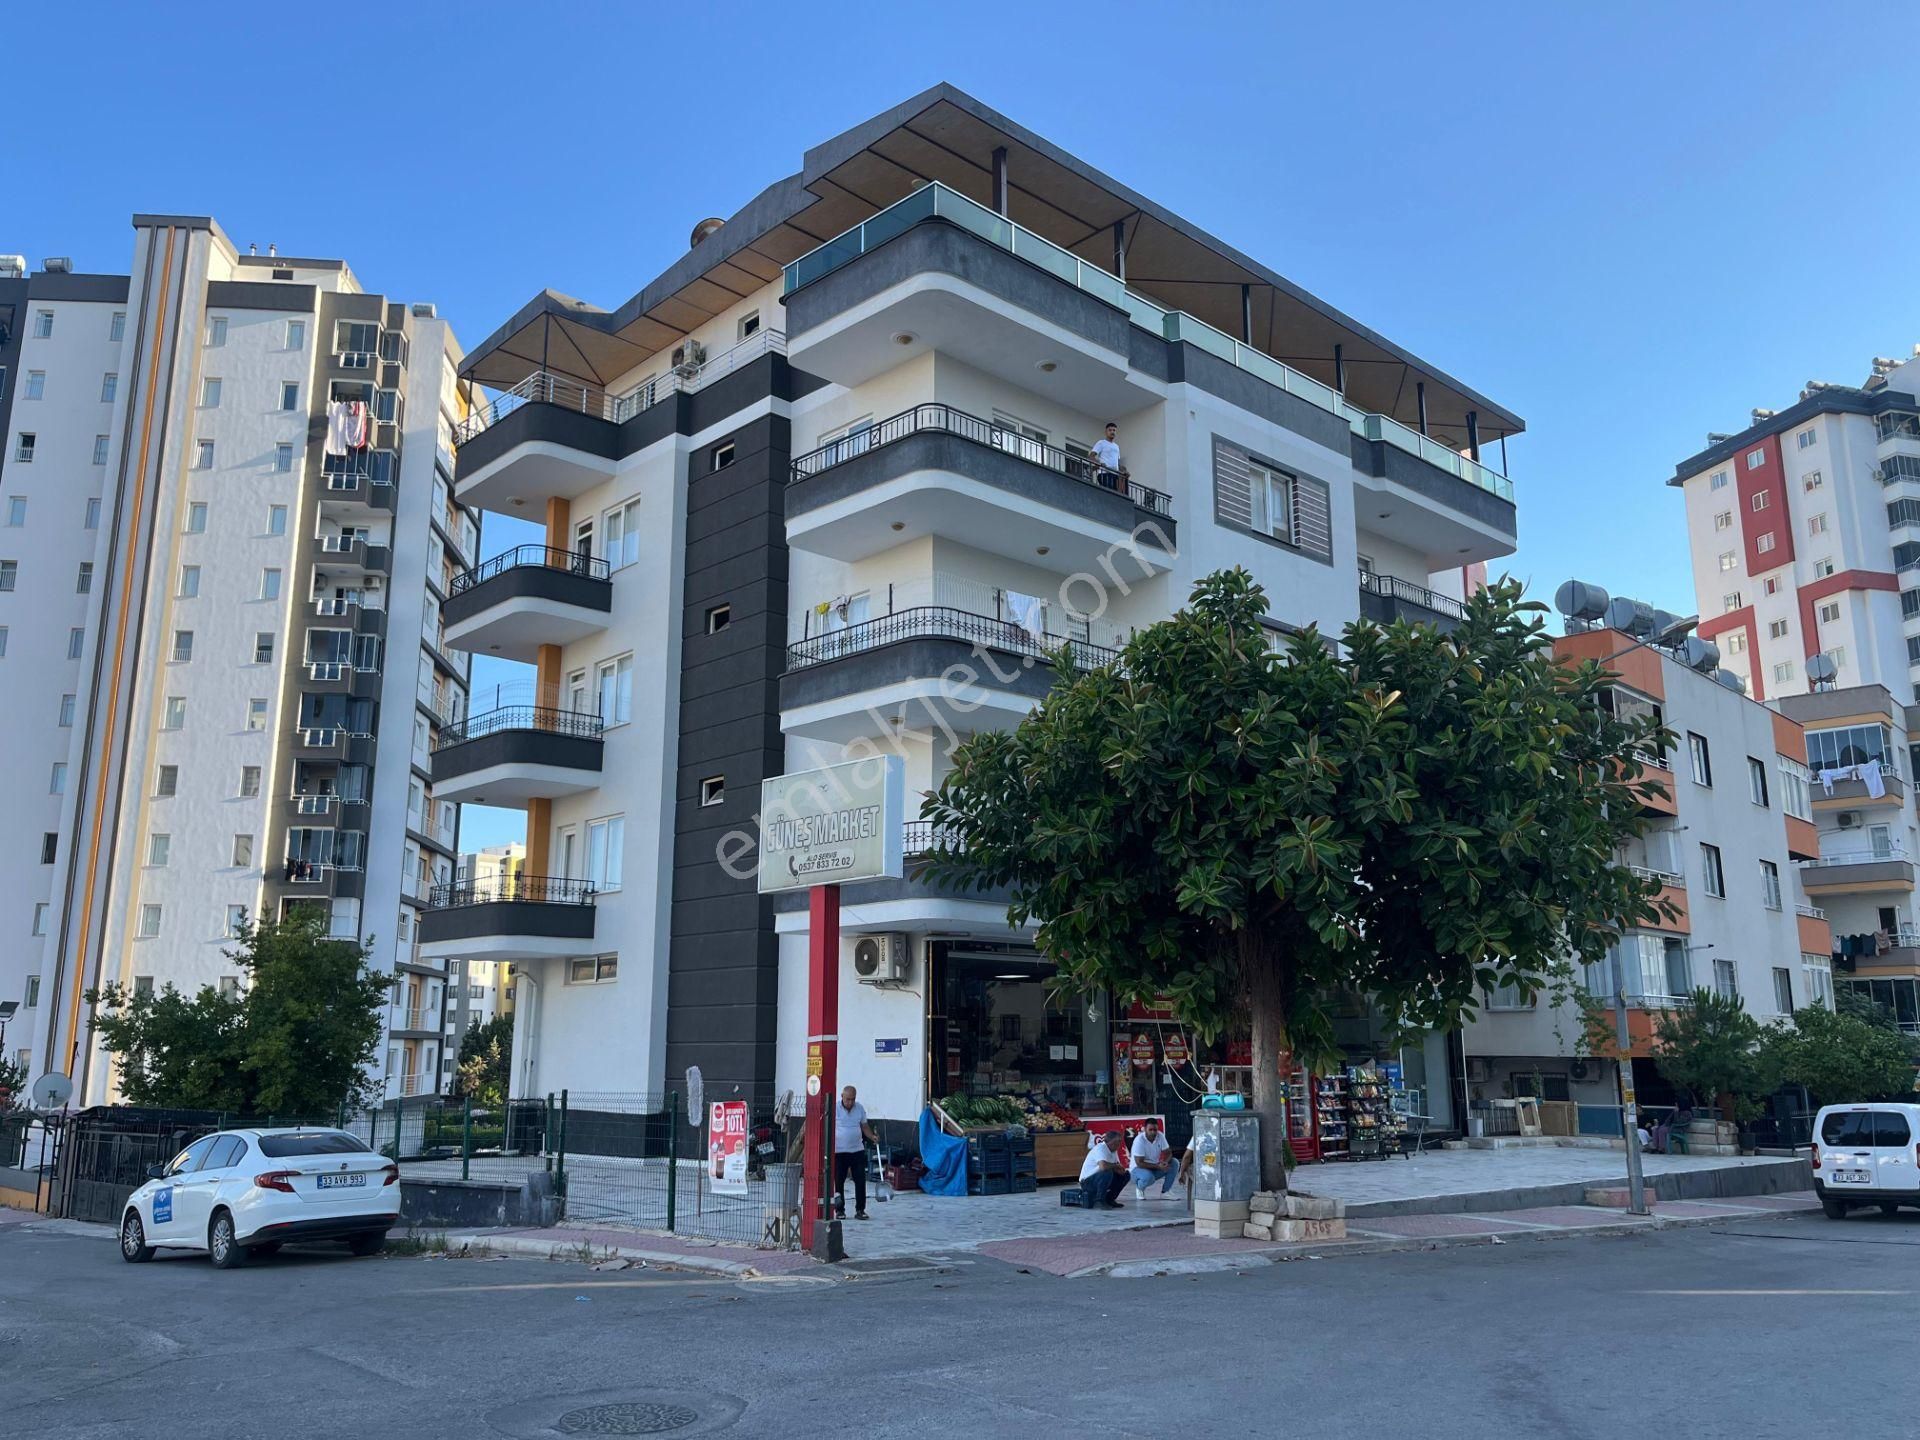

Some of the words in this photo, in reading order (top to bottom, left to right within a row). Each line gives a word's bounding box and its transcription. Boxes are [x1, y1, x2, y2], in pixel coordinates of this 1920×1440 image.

[767, 813, 813, 853] GÜNEŞ
[814, 805, 880, 846] MARKET
[798, 861, 815, 872] 0537
[816, 860, 829, 869] 833
[831, 858, 840, 867] 72
[841, 856, 851, 866] 02
[323, 1176, 333, 1185] 33
[335, 1175, 348, 1185] AVB
[350, 1174, 364, 1184] 993
